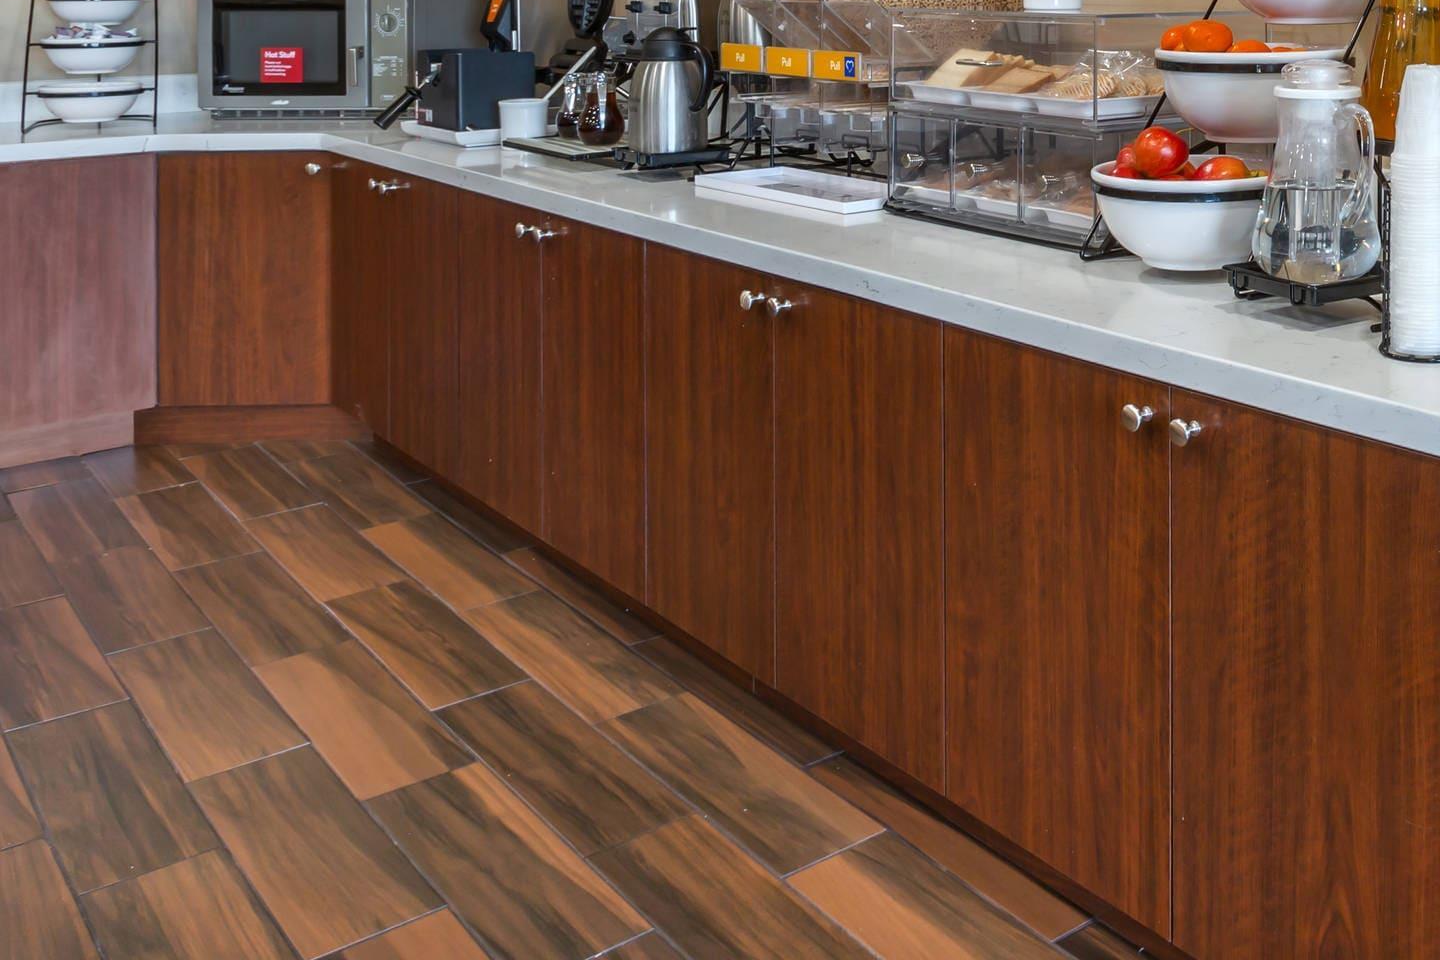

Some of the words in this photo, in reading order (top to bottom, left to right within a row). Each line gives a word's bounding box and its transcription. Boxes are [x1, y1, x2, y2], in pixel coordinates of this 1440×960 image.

[264, 51, 278, 59] Hot
[279, 51, 296, 59] Stuff
[735, 52, 745, 63] Pull
[781, 56, 792, 67] Pull
[829, 60, 841, 71] Pull
